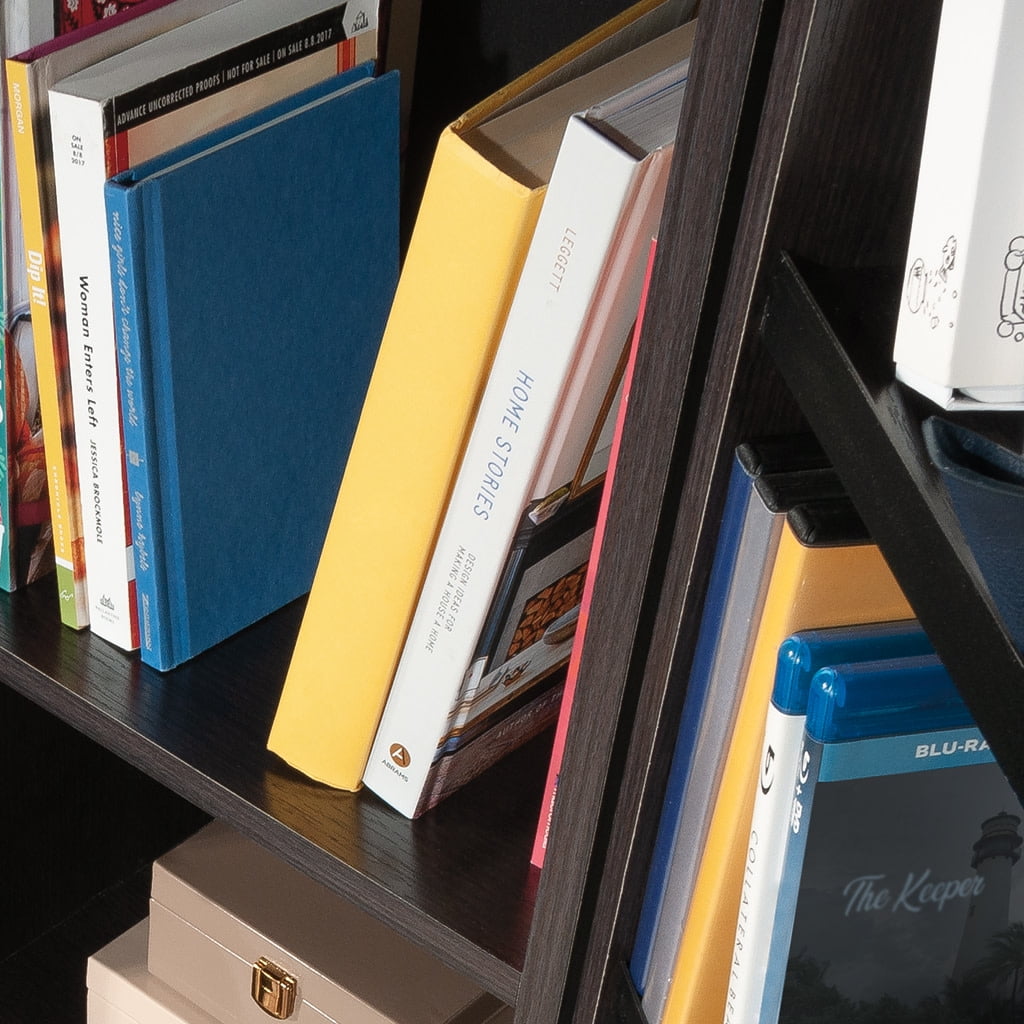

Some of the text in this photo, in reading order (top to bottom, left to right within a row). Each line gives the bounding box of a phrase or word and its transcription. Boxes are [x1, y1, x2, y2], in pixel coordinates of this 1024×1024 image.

[12, 82, 25, 134] MORGAN
[117, 107, 147, 126] ADVANCE
[148, 86, 194, 112] UNCORRECTED
[195, 74, 220, 97] PROOFS
[227, 64, 240, 81] NOT
[241, 60, 255, 76] FOR
[256, 54, 270, 71] SALE
[277, 45, 286, 60] ON
[288, 40, 303, 57] SALE
[304, 29, 332, 51] 8.8.2017
[71, 135, 81, 143] ON
[71, 142, 83, 151] SALE
[71, 157, 85, 166] 2017
[26, 249, 47, 307] Dip It!
[549, 227, 576, 293] LEGGETT
[79, 275, 98, 428] Woman Enters Left
[473, 369, 535, 521] HOME STORIES
[90, 439, 104, 545] JESSICA BROCKMOLE
[425, 545, 466, 654] MAKING A HOUSE A HOME
[444, 552, 477, 633] DESIGN IDEAS FOR
[381, 758, 409, 783] ABRAMS
[914, 738, 991, 759] BLU-RA
[732, 830, 759, 979] COLLATERAL
[843, 868, 986, 917] The Keeper
